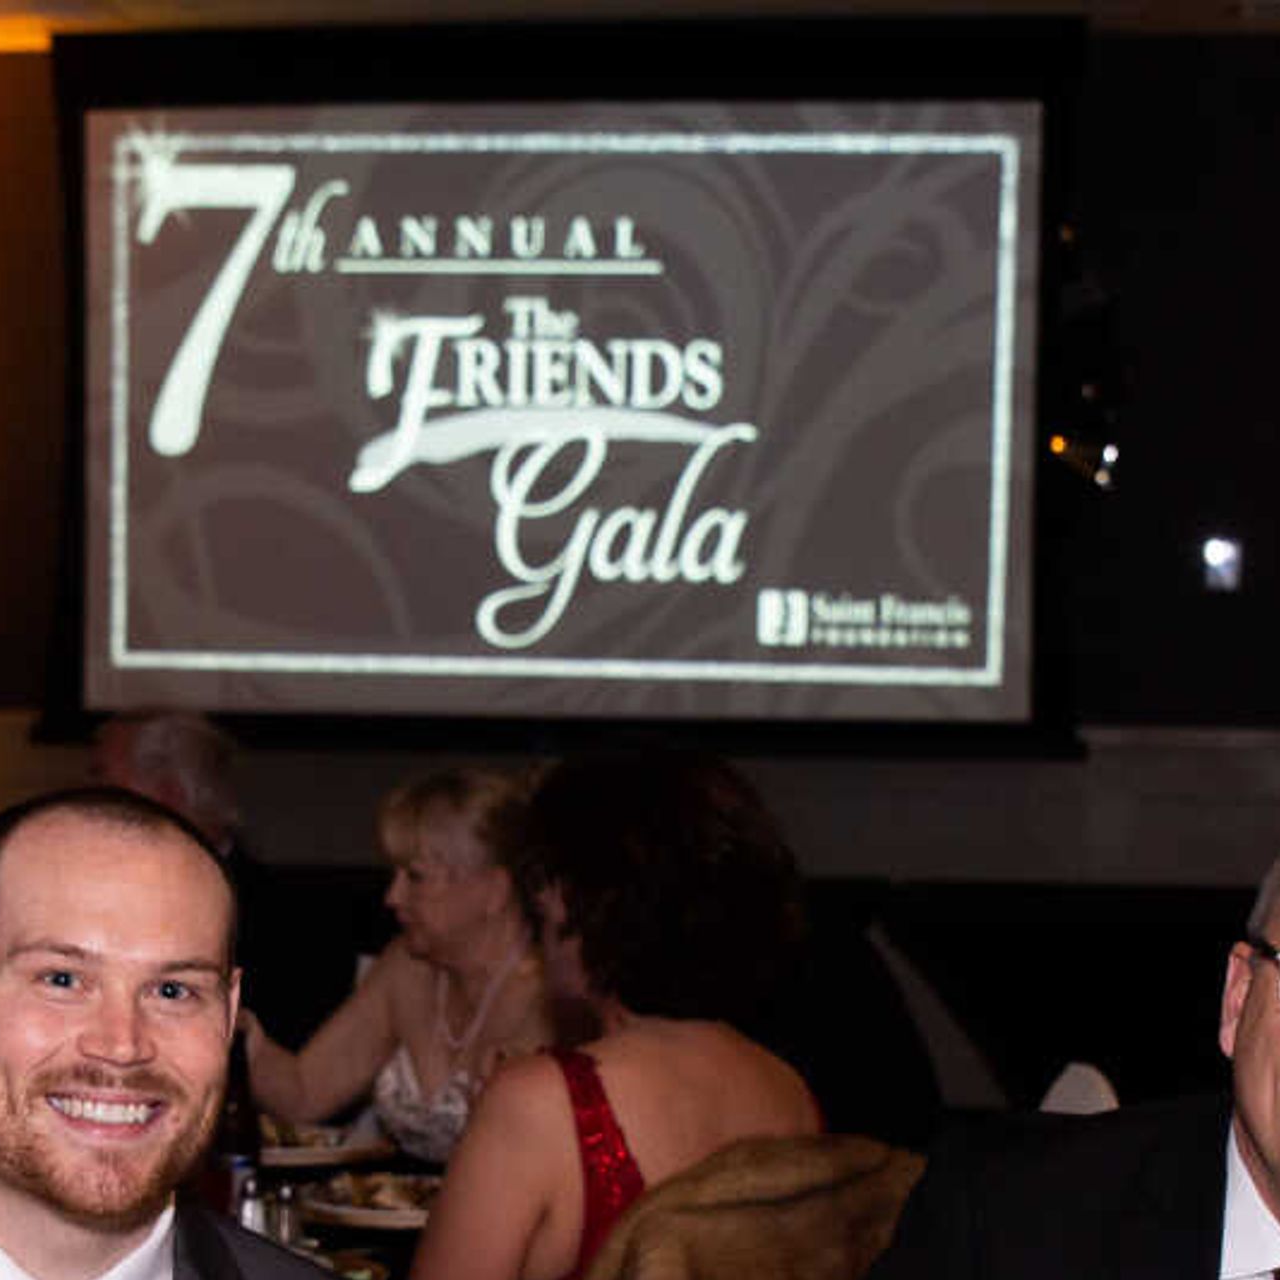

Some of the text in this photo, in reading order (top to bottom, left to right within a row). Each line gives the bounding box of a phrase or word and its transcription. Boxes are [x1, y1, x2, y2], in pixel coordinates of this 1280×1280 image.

[136, 162, 646, 456] 7th ANNUAL
[349, 313, 723, 493] FRIENDS
[503, 297, 580, 340] The
[476, 424, 758, 648] Gala
